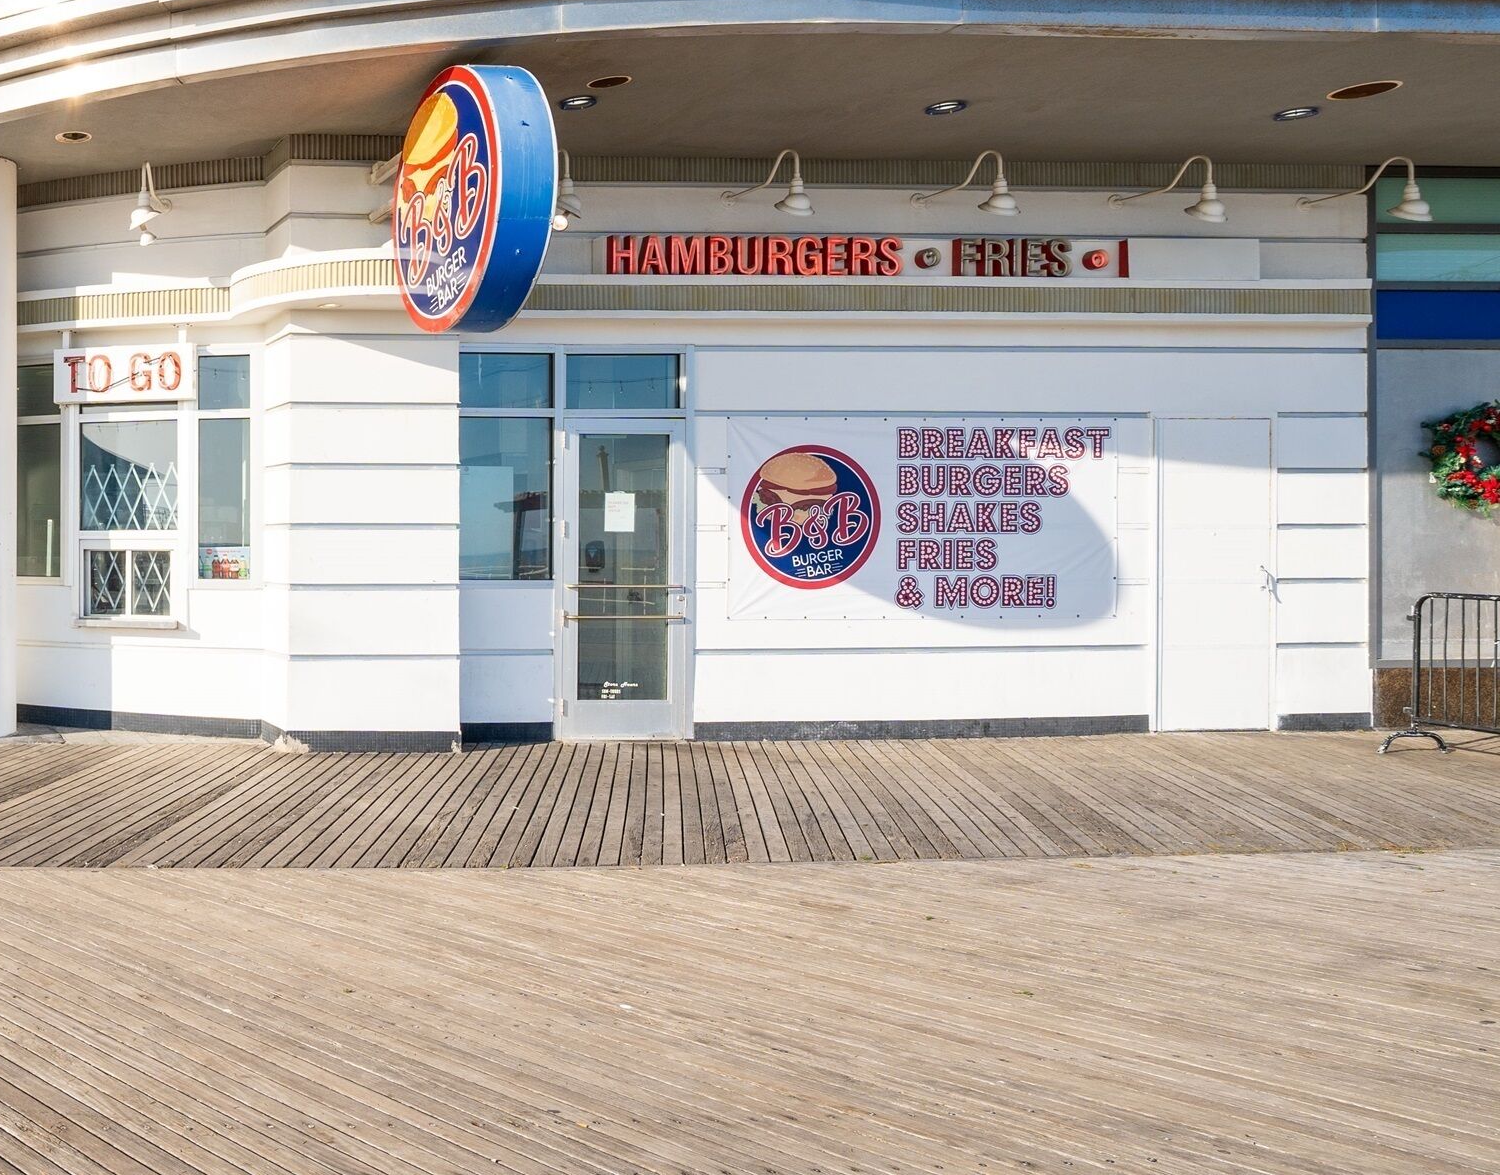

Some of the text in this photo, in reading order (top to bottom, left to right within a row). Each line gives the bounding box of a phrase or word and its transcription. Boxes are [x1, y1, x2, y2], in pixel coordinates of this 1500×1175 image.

[401, 133, 487, 288] B&B
[426, 246, 467, 297] BURGER
[606, 235, 1073, 278] HAMBURGERS FRIES
[437, 279, 459, 311] BAR
[64, 351, 181, 393] TO GO
[897, 427, 1111, 460] BREAKFAST
[897, 463, 1070, 497] BURGERS
[756, 491, 869, 557] B&B
[897, 501, 1042, 534] SHAKES
[792, 549, 843, 567] BURGER
[807, 563, 832, 578] BAR
[897, 537, 998, 572] FRIES
[895, 574, 1057, 610] & MORE!
